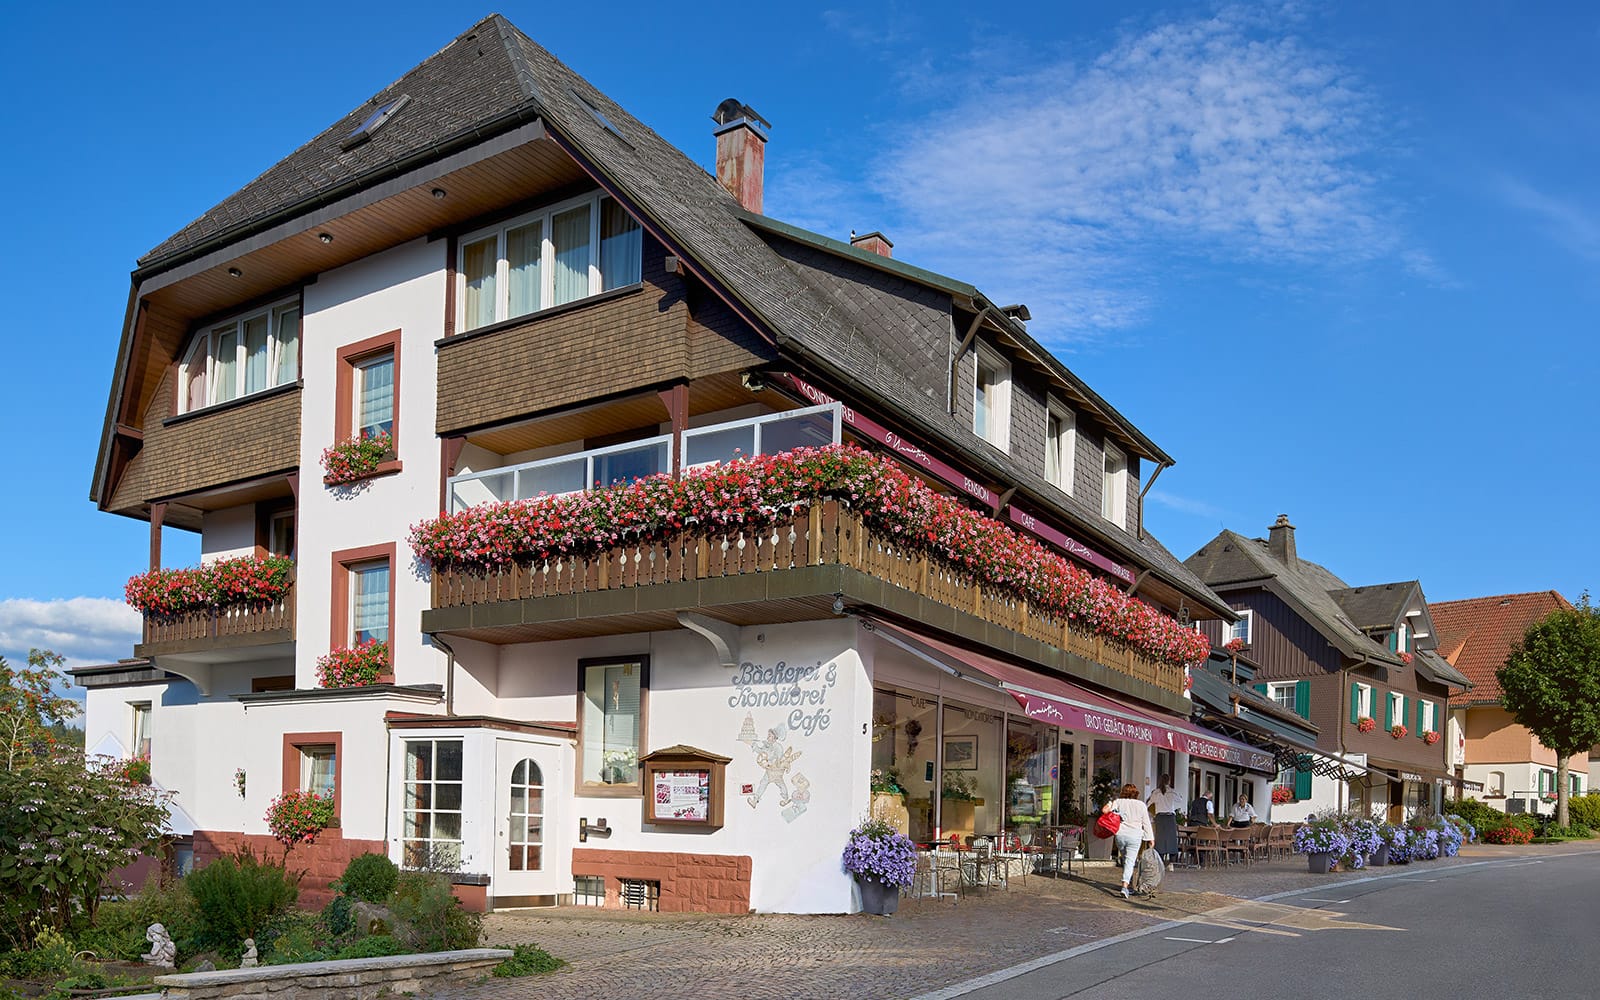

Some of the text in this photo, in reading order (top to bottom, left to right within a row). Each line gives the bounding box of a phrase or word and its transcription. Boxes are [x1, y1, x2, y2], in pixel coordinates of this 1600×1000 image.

[963, 477, 990, 502] PENSION
[732, 660, 821, 686] Bäckerei
[728, 684, 827, 708] Konditorei
[787, 708, 832, 737] Café
[861, 722, 868, 735] 5
